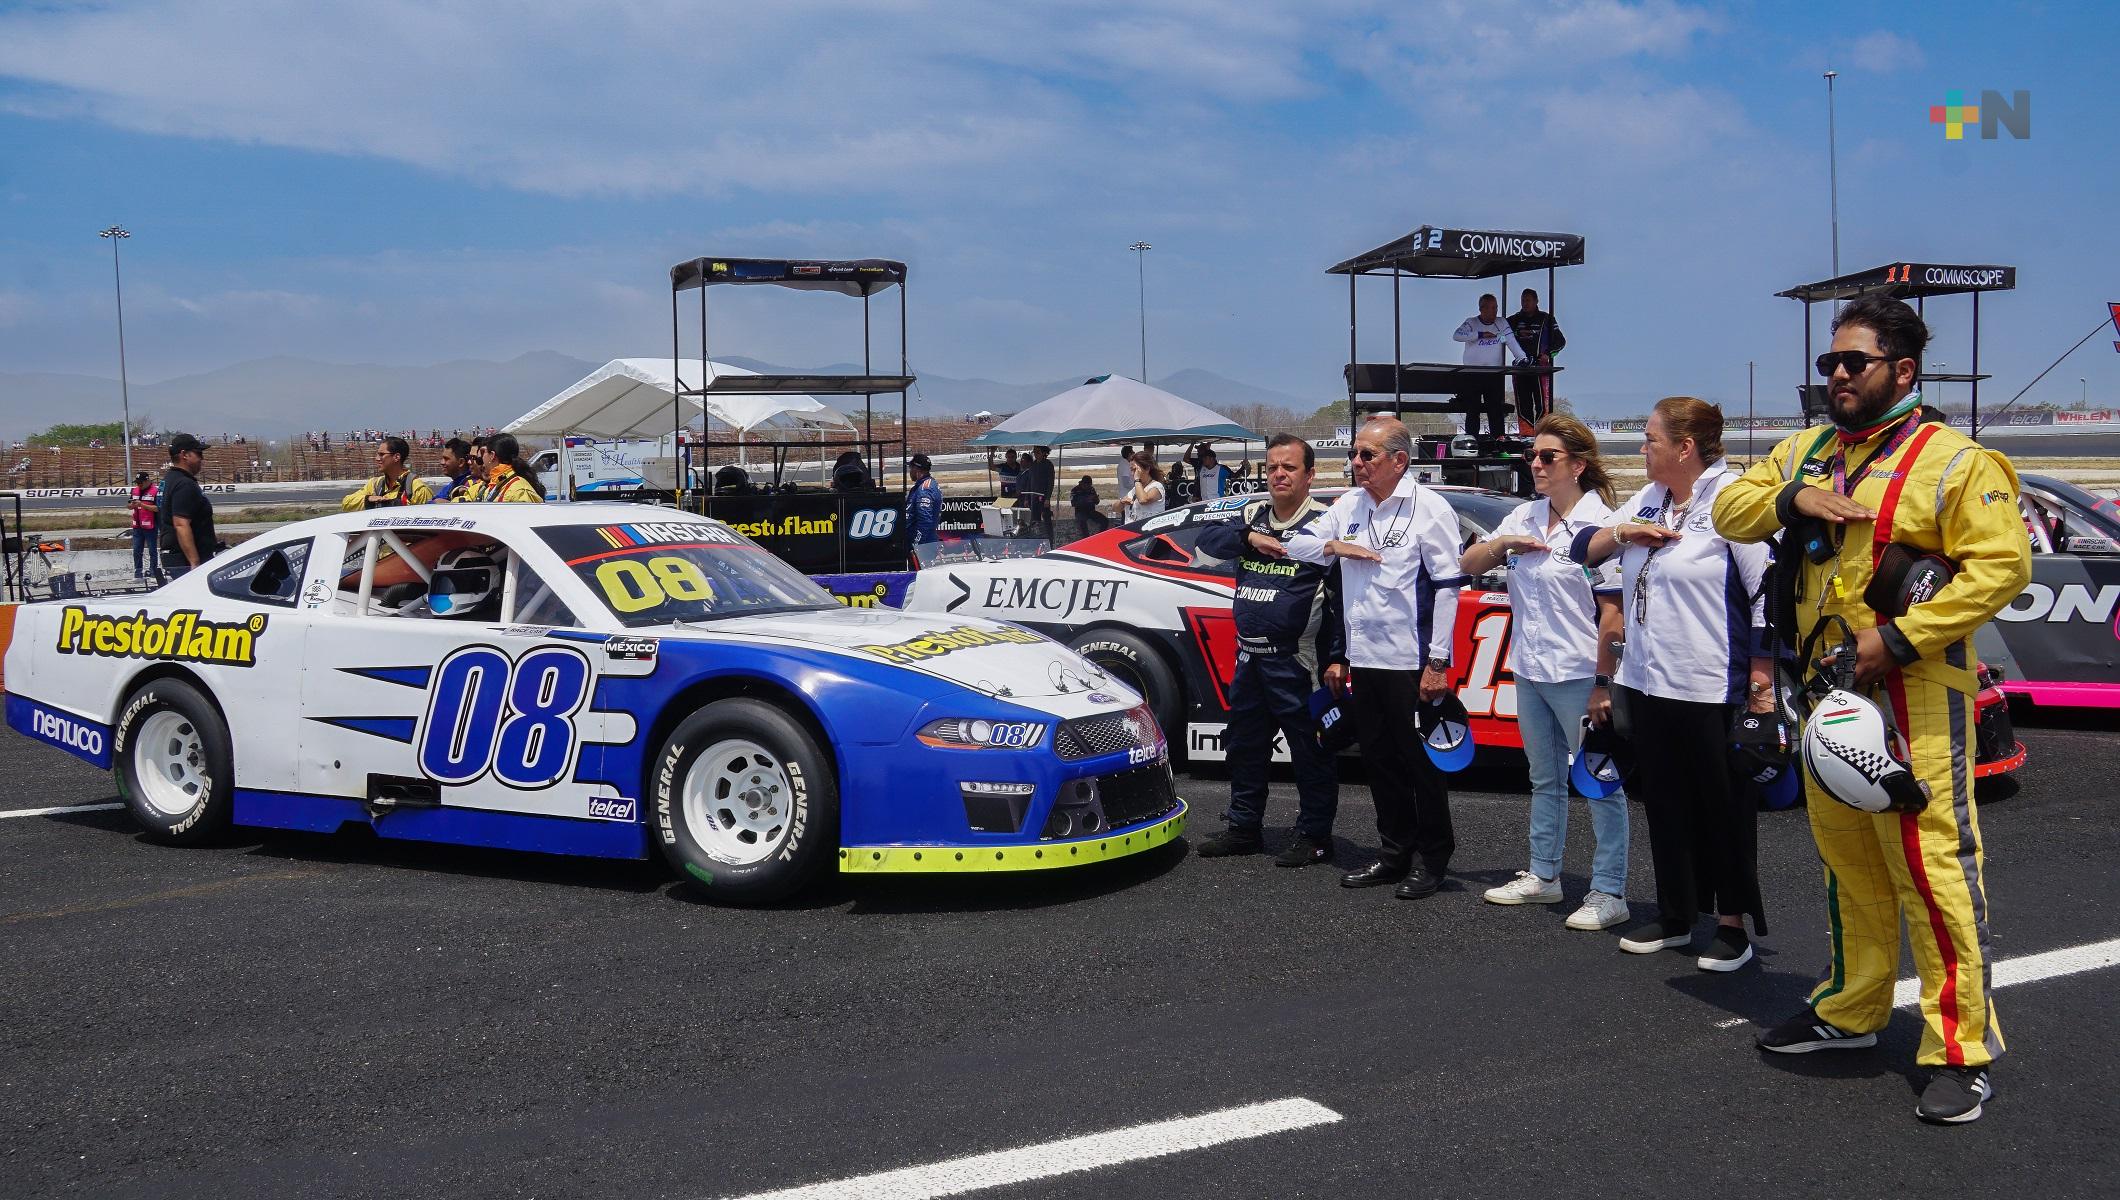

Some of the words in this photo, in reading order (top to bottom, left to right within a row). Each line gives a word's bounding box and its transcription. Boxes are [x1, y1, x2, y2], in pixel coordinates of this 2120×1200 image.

[1428, 230, 1443, 248] 2
[2009, 414, 2044, 425] telcel
[26, 489, 84, 498] SUPER
[97, 488, 128, 496] OVA
[941, 501, 993, 512] OMMSCOPE
[850, 509, 898, 539] 08
[1636, 506, 1660, 519] 08
[596, 557, 714, 613] 08
[982, 577, 1129, 620] EMCJET
[1994, 583, 2120, 623] ON
[33, 708, 102, 756] nenuco
[114, 692, 158, 753] GENERAL
[417, 643, 592, 792] 08
[990, 724, 1025, 746] 08
[1128, 741, 1157, 765] telcel
[168, 776, 213, 835] GENERAL
[589, 798, 633, 818] telcel
[657, 743, 685, 844] GENERAL
[778, 760, 809, 862] GENERAL
